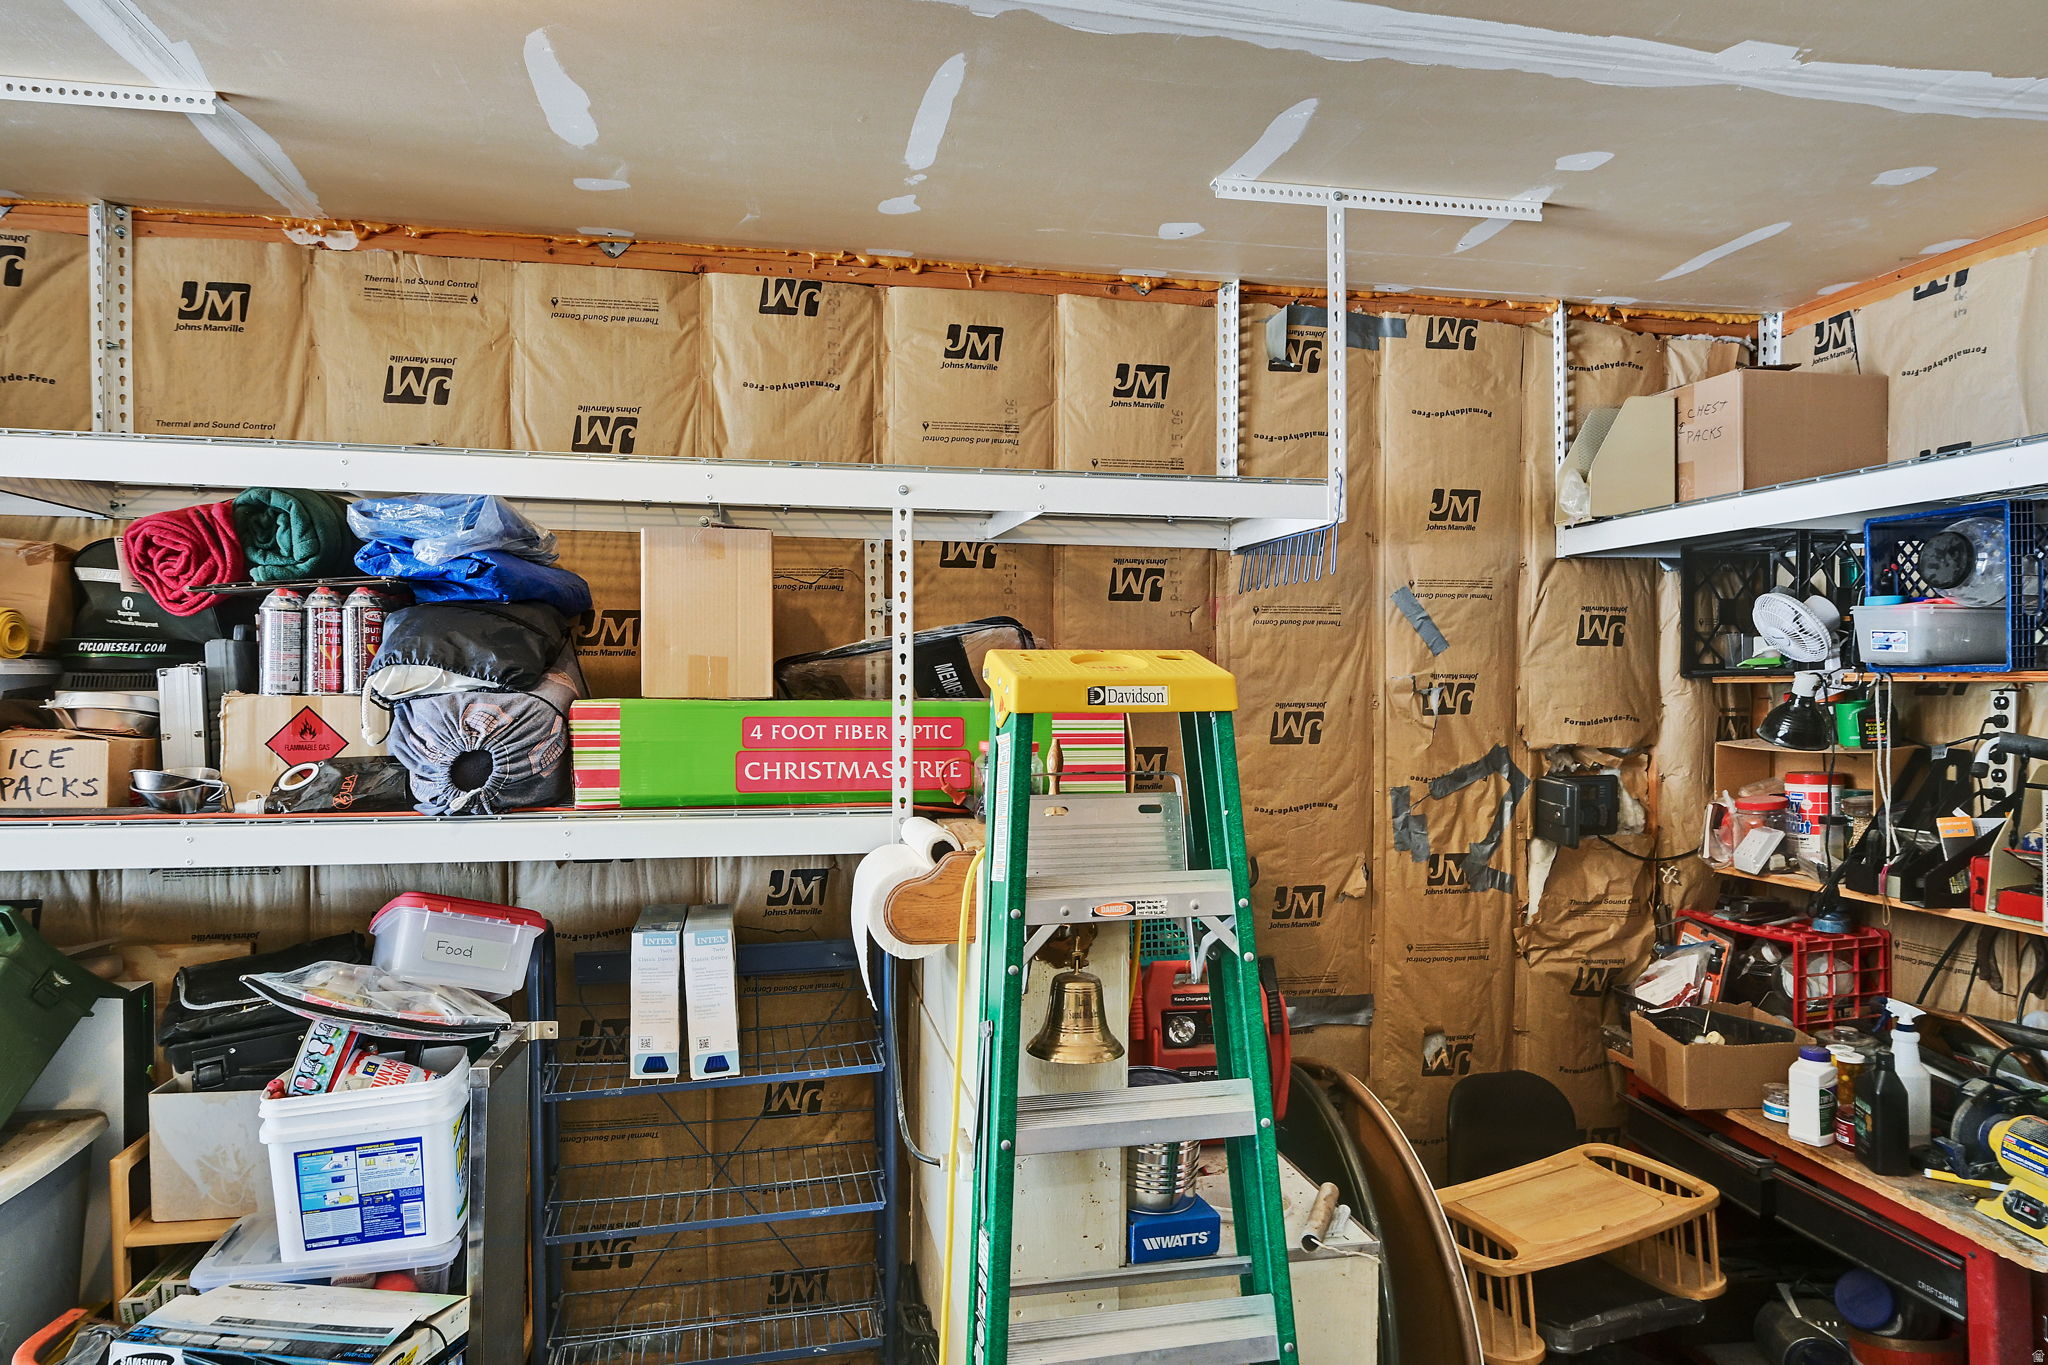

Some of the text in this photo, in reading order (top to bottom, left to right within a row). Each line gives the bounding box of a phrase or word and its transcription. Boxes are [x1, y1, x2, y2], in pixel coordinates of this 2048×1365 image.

[364, 274, 479, 289] Thermal nd Sound Control
[177, 280, 252, 323] JM
[758, 277, 823, 317] JM
[551, 311, 660, 326] Thermal and Sound Control
[174, 323, 245, 333] Johns Manville
[1425, 316, 1479, 351] JM
[1813, 310, 1856, 356] JM
[943, 323, 1005, 362] JM
[389, 355, 458, 366] Johns Manville
[940, 361, 998, 371] Johns Manville
[1566, 360, 1645, 373] ormaldehyde-Free
[1901, 345, 1988, 377] Formaldehyde-Free
[382, 364, 454, 406] JM
[742, 380, 841, 392] Formaldehyde-Free
[1112, 362, 1171, 401] JM
[577, 404, 642, 415] Johns Manville
[1109, 400, 1166, 410] Johns Manville
[1687, 400, 1728, 419] CHEST
[1411, 406, 1494, 419] Formaldehyde-Free
[156, 419, 277, 431] Thermal and Sound Control
[571, 414, 639, 455] JM
[922, 435, 1020, 447] Thermal and Sound Control
[1253, 430, 1329, 443] rmaldehyde-Free
[1687, 426, 1723, 444] PACKS
[1428, 488, 1482, 523] JM
[1426, 523, 1477, 533] Johns Manville
[1113, 557, 1168, 566] Johns Manville
[798, 583, 814, 592] and
[815, 583, 845, 592] Thermal
[1107, 566, 1166, 602] JM
[1437, 592, 1456, 600] Sound
[1457, 592, 1469, 600] and
[1469, 592, 1493, 601] Thermal
[1252, 618, 1343, 628] Thermal and Sound Control
[1576, 614, 1627, 647] JM
[78, 641, 167, 653] CYCLONESEAT.COM
[600, 649, 637, 657] Manville
[1430, 672, 1480, 681] Johns Manville
[1107, 687, 1165, 704] Davidson
[1275, 701, 1327, 710] Johns Manville
[1564, 714, 1641, 726] Formaldehyde-Free
[750, 724, 953, 740] 4 FOOT FIBER PTIC
[1269, 710, 1325, 745] JM
[284, 743, 318, 751] FLAMMABLE
[8, 747, 74, 770] ICE
[744, 760, 963, 781] CHRISTMAS TREE
[0, 775, 99, 801] PACKS
[1254, 802, 1339, 816] Formaldehyde-Free
[766, 868, 829, 907] JM
[1424, 887, 1444, 896] Johns
[1271, 884, 1327, 919] JM
[763, 907, 823, 918] Johns Manville
[1101, 904, 1128, 914] DANGER
[1268, 920, 1321, 931] Johns Manville
[191, 932, 231, 942] Manville
[555, 926, 632, 942] aldehyde-Free
[697, 935, 726, 945] INTEX
[645, 937, 674, 945] INTEX
[436, 940, 474, 959] Food
[1158, 1231, 1208, 1249] WATTS
[1917, 1280, 1959, 1309] CRAFTSMAN
[119, 1357, 168, 1365] SAMSUNG
